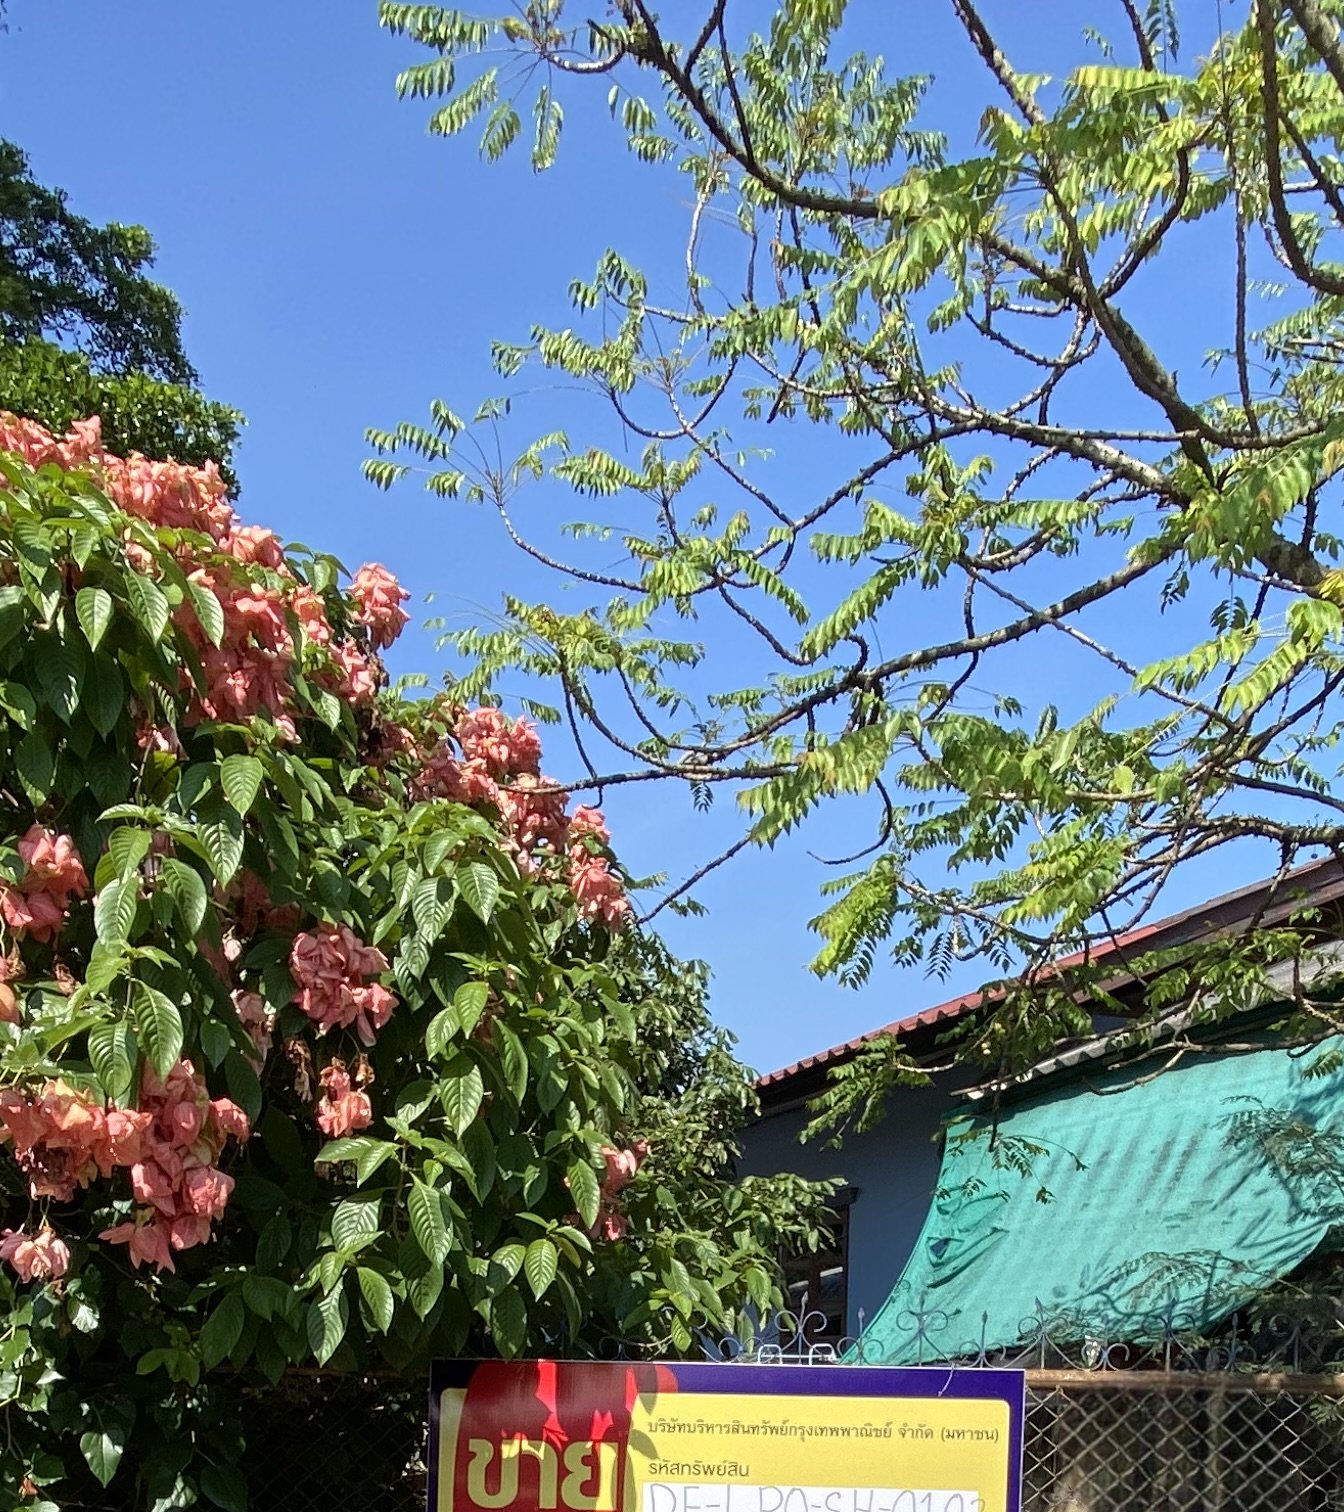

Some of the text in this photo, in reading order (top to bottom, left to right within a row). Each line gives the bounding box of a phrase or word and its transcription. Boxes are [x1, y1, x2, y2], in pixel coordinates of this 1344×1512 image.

[647, 1417, 1000, 1443] บริษัทบริหารสินทรัพย์กรุงเทพพาณิชย์ จำกัด (มหาชน)
[467, 1438, 619, 1511] ขาย
[648, 1458, 750, 1477] รหัสทรัพย์สิน
